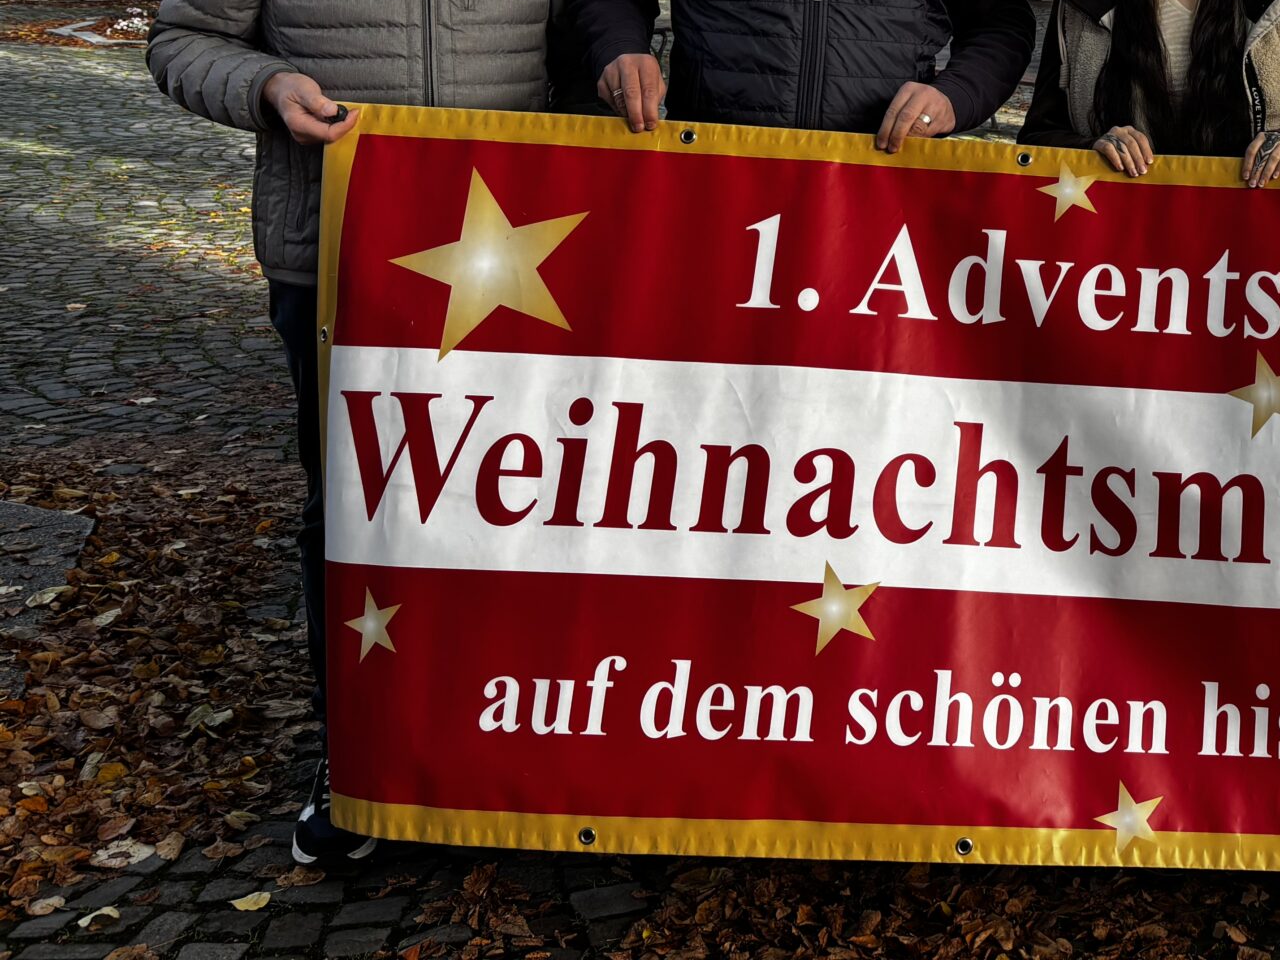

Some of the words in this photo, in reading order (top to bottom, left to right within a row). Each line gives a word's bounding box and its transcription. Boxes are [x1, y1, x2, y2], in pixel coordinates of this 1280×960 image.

[1251, 87, 1262, 111] LOVE
[735, 213, 820, 312] 1.
[478, 655, 628, 736] auf
[639, 659, 815, 742] dem
[845, 670, 1170, 755] schönen
